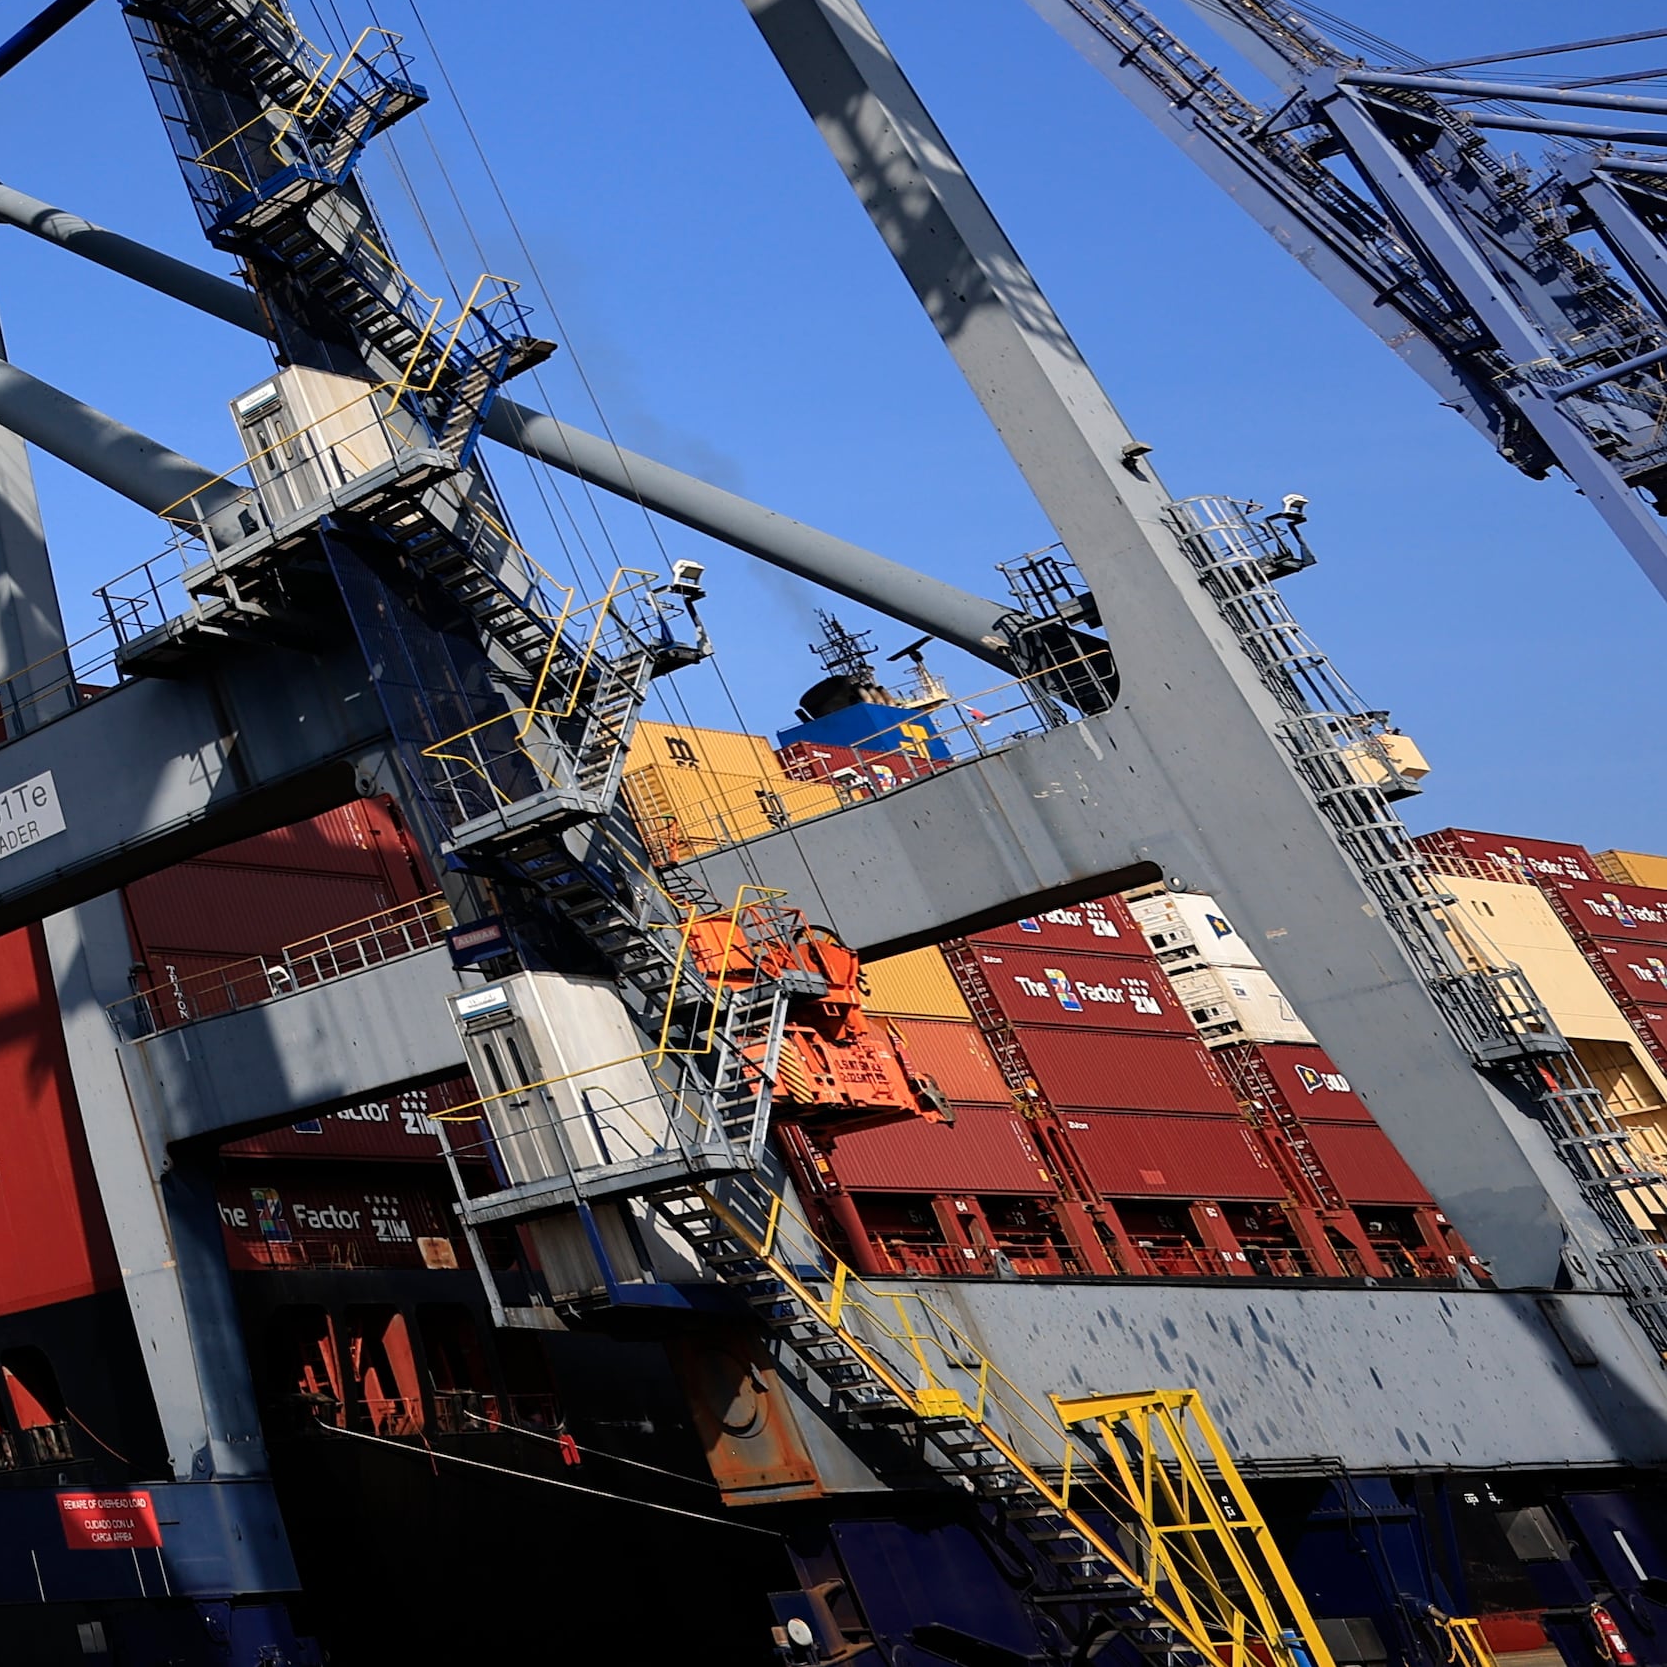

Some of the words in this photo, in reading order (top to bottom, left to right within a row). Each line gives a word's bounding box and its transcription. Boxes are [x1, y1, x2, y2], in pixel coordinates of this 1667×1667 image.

[1582, 899, 1613, 917] The
[1625, 904, 1665, 923] Factor
[457, 929, 497, 947] ALIMAK
[1087, 918, 1121, 938] ZIM
[1627, 963, 1657, 982] The
[165, 965, 190, 1020] TRITON
[1014, 975, 1051, 998] The
[1075, 981, 1127, 1003] Factor
[1129, 994, 1163, 1016] ZIM
[1320, 1072, 1353, 1093] GOLD
[217, 1201, 250, 1228] he
[292, 1204, 361, 1230] Factor
[370, 1219, 413, 1243] ZIM
[63, 1499, 88, 1510] BEWARE
[88, 1499, 97, 1509] OF
[97, 1498, 128, 1509] OVERHEAD
[128, 1498, 146, 1508] LOAD
[84, 1520, 111, 1530] CUIDADO
[112, 1519, 126, 1529] CON
[126, 1519, 135, 1528] LA
[91, 1533, 112, 1543] CARGA
[113, 1532, 133, 1542] ARRIBA
